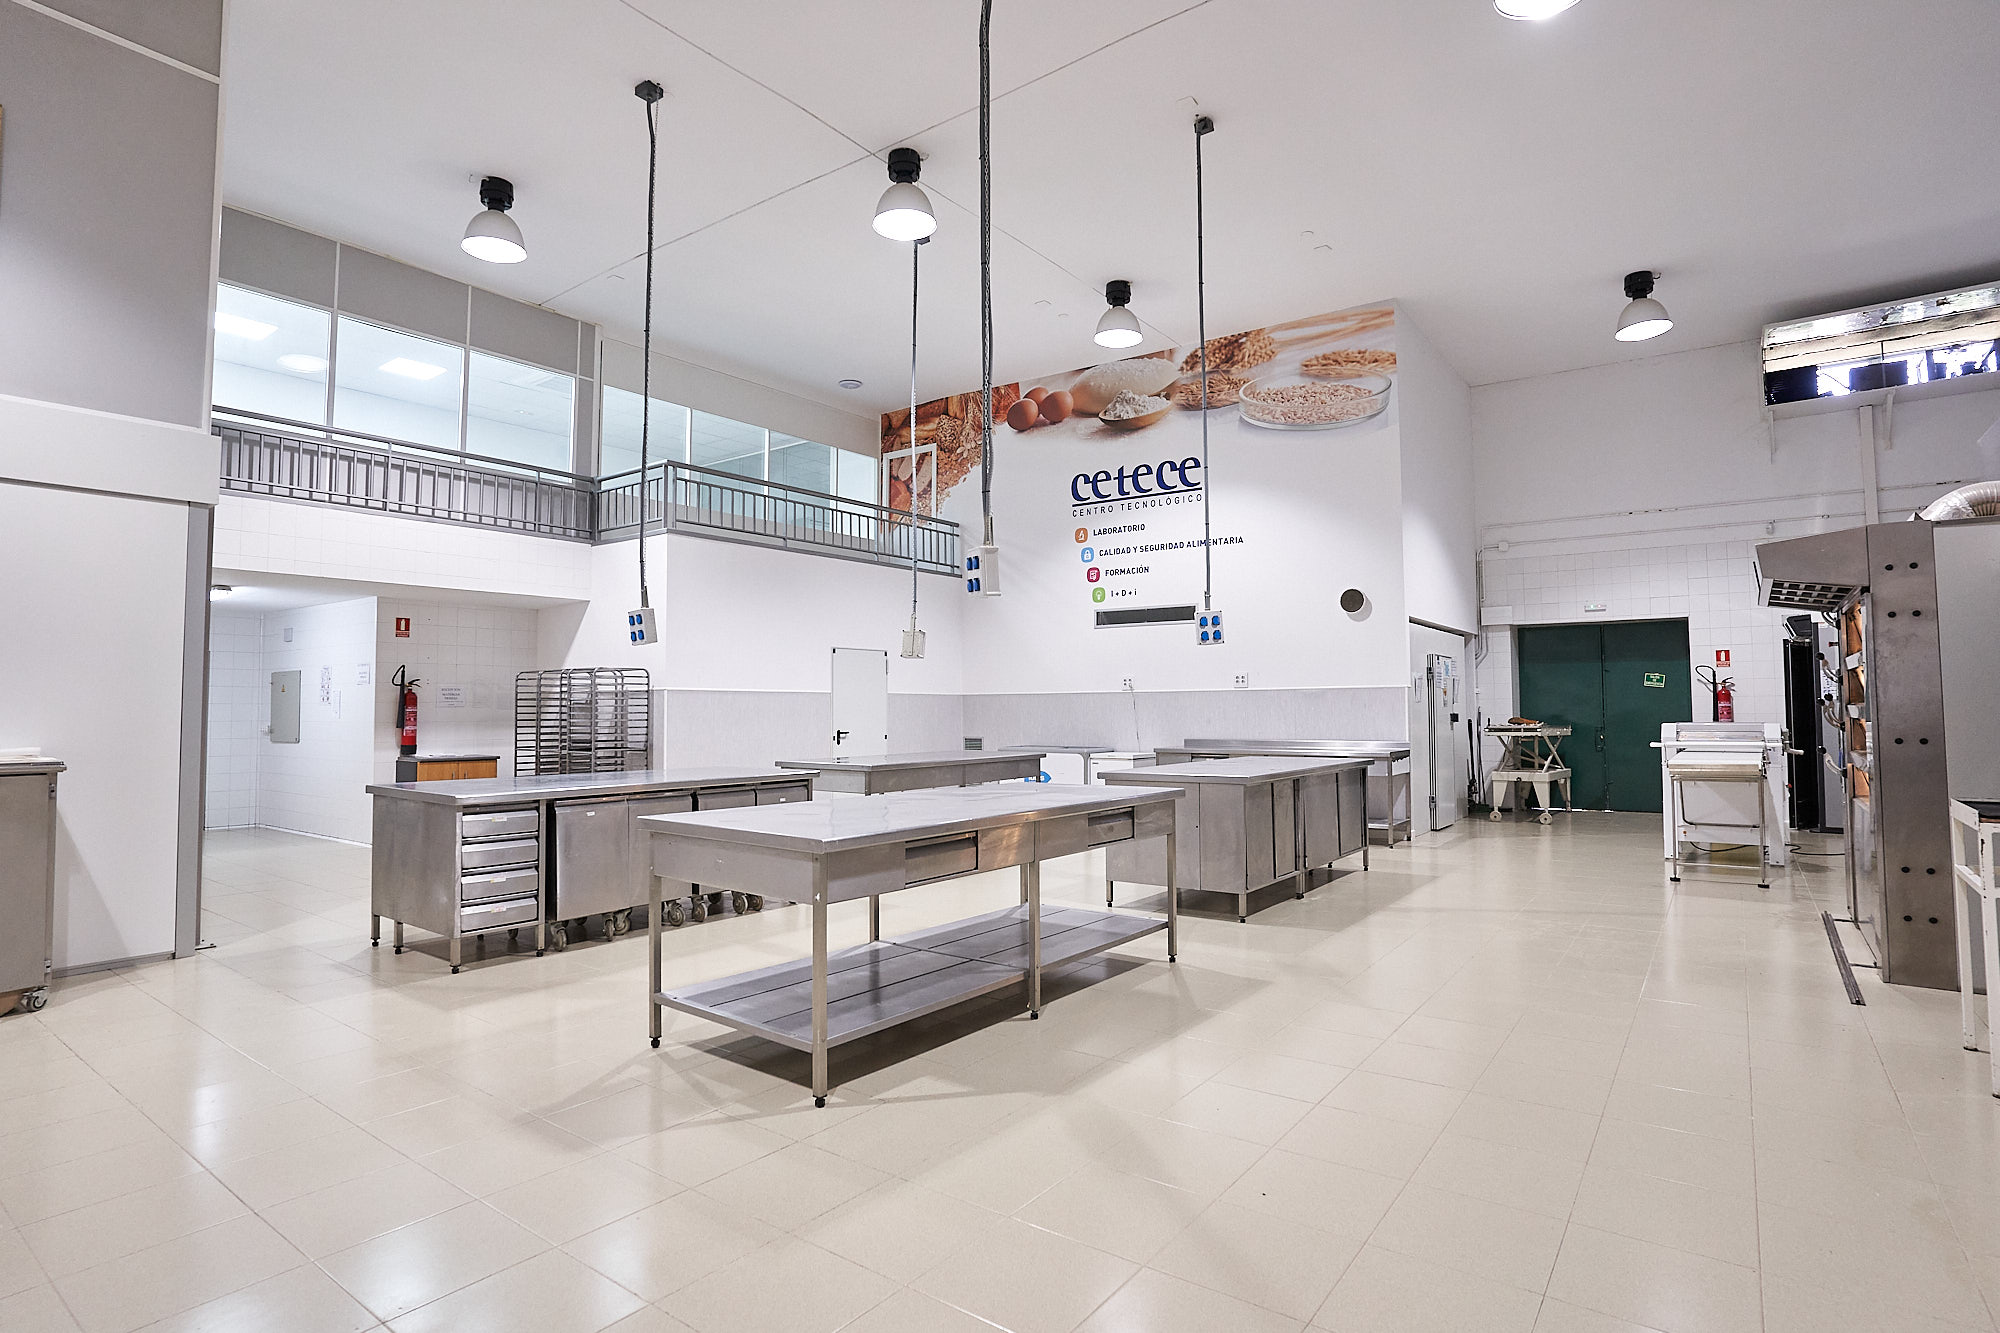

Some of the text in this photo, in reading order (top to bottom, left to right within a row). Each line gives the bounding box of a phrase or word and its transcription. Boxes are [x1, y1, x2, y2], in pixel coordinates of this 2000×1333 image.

[1071, 456, 1201, 501] cetece
[1072, 493, 1202, 517] CENTRO TECNOLÓGICO
[1093, 523, 1146, 536] LABORATORIO
[1099, 536, 1244, 557] CALIDAD Y SEGURIDAD ALIMENTARIA
[1105, 565, 1150, 577] FORMACIÓN
